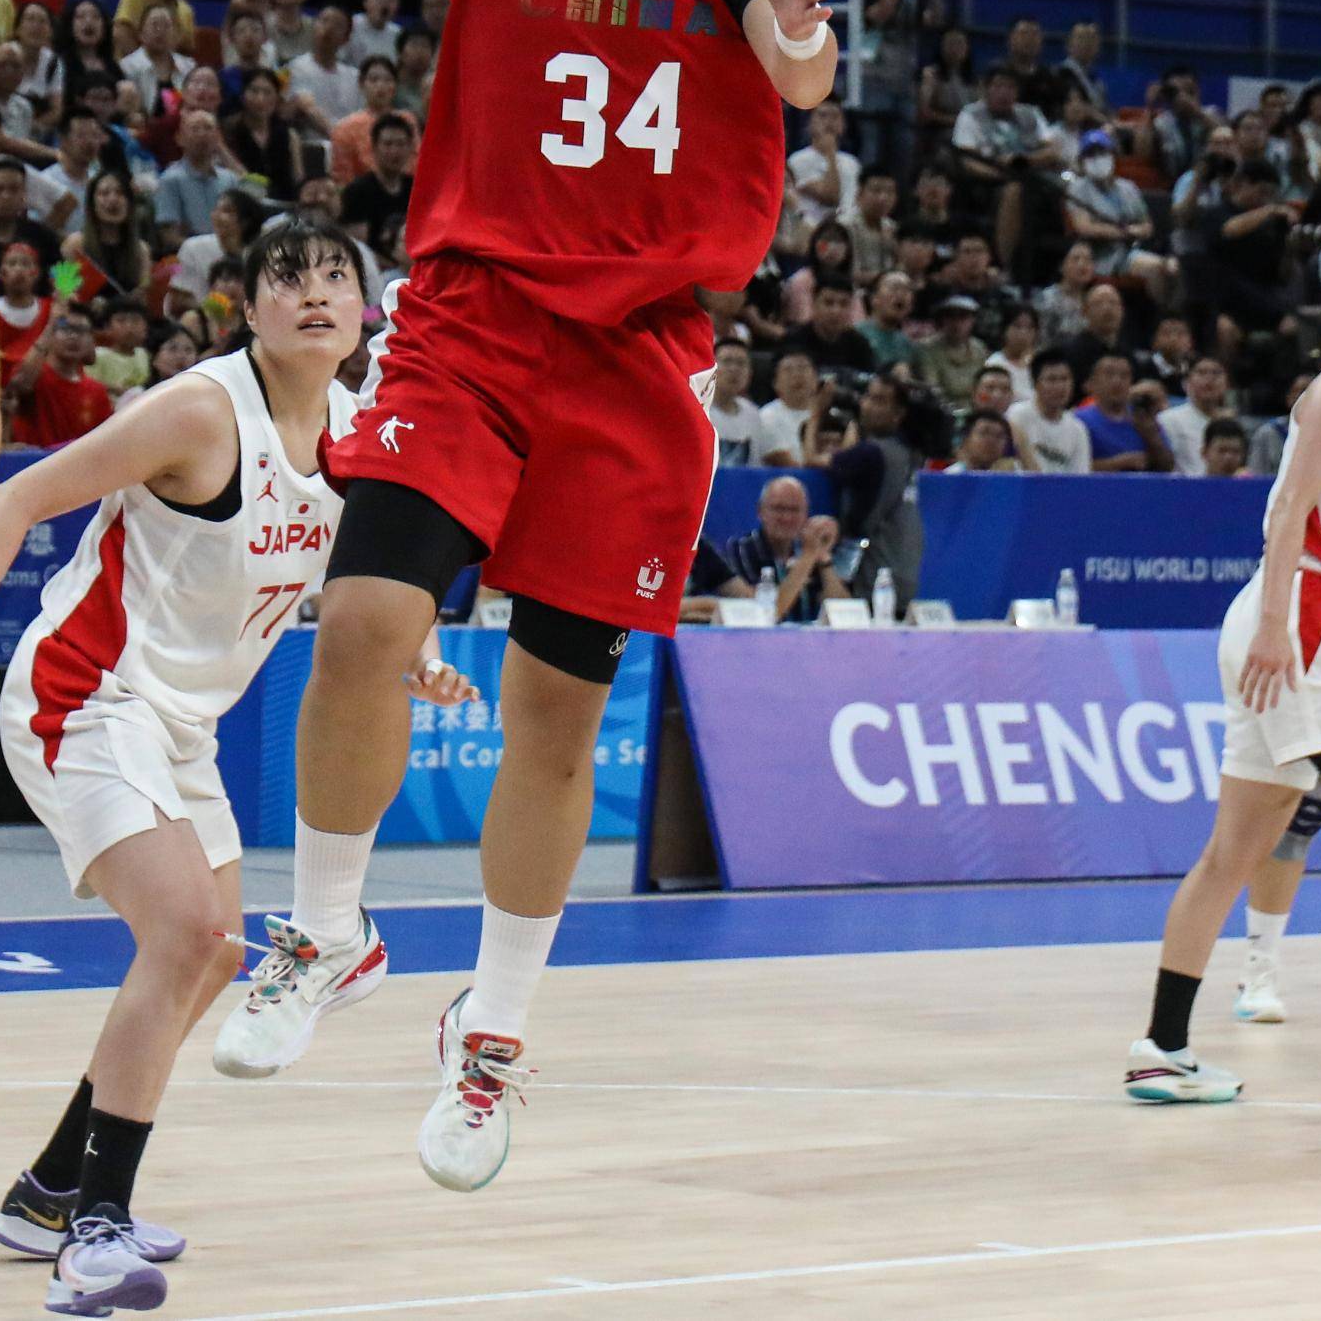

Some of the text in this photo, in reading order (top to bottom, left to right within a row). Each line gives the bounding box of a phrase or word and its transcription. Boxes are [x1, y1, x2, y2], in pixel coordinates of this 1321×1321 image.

[540, 51, 682, 175] 34
[1084, 556, 1132, 583] FISU
[1133, 556, 1210, 583] WORLD
[238, 581, 307, 642] 77
